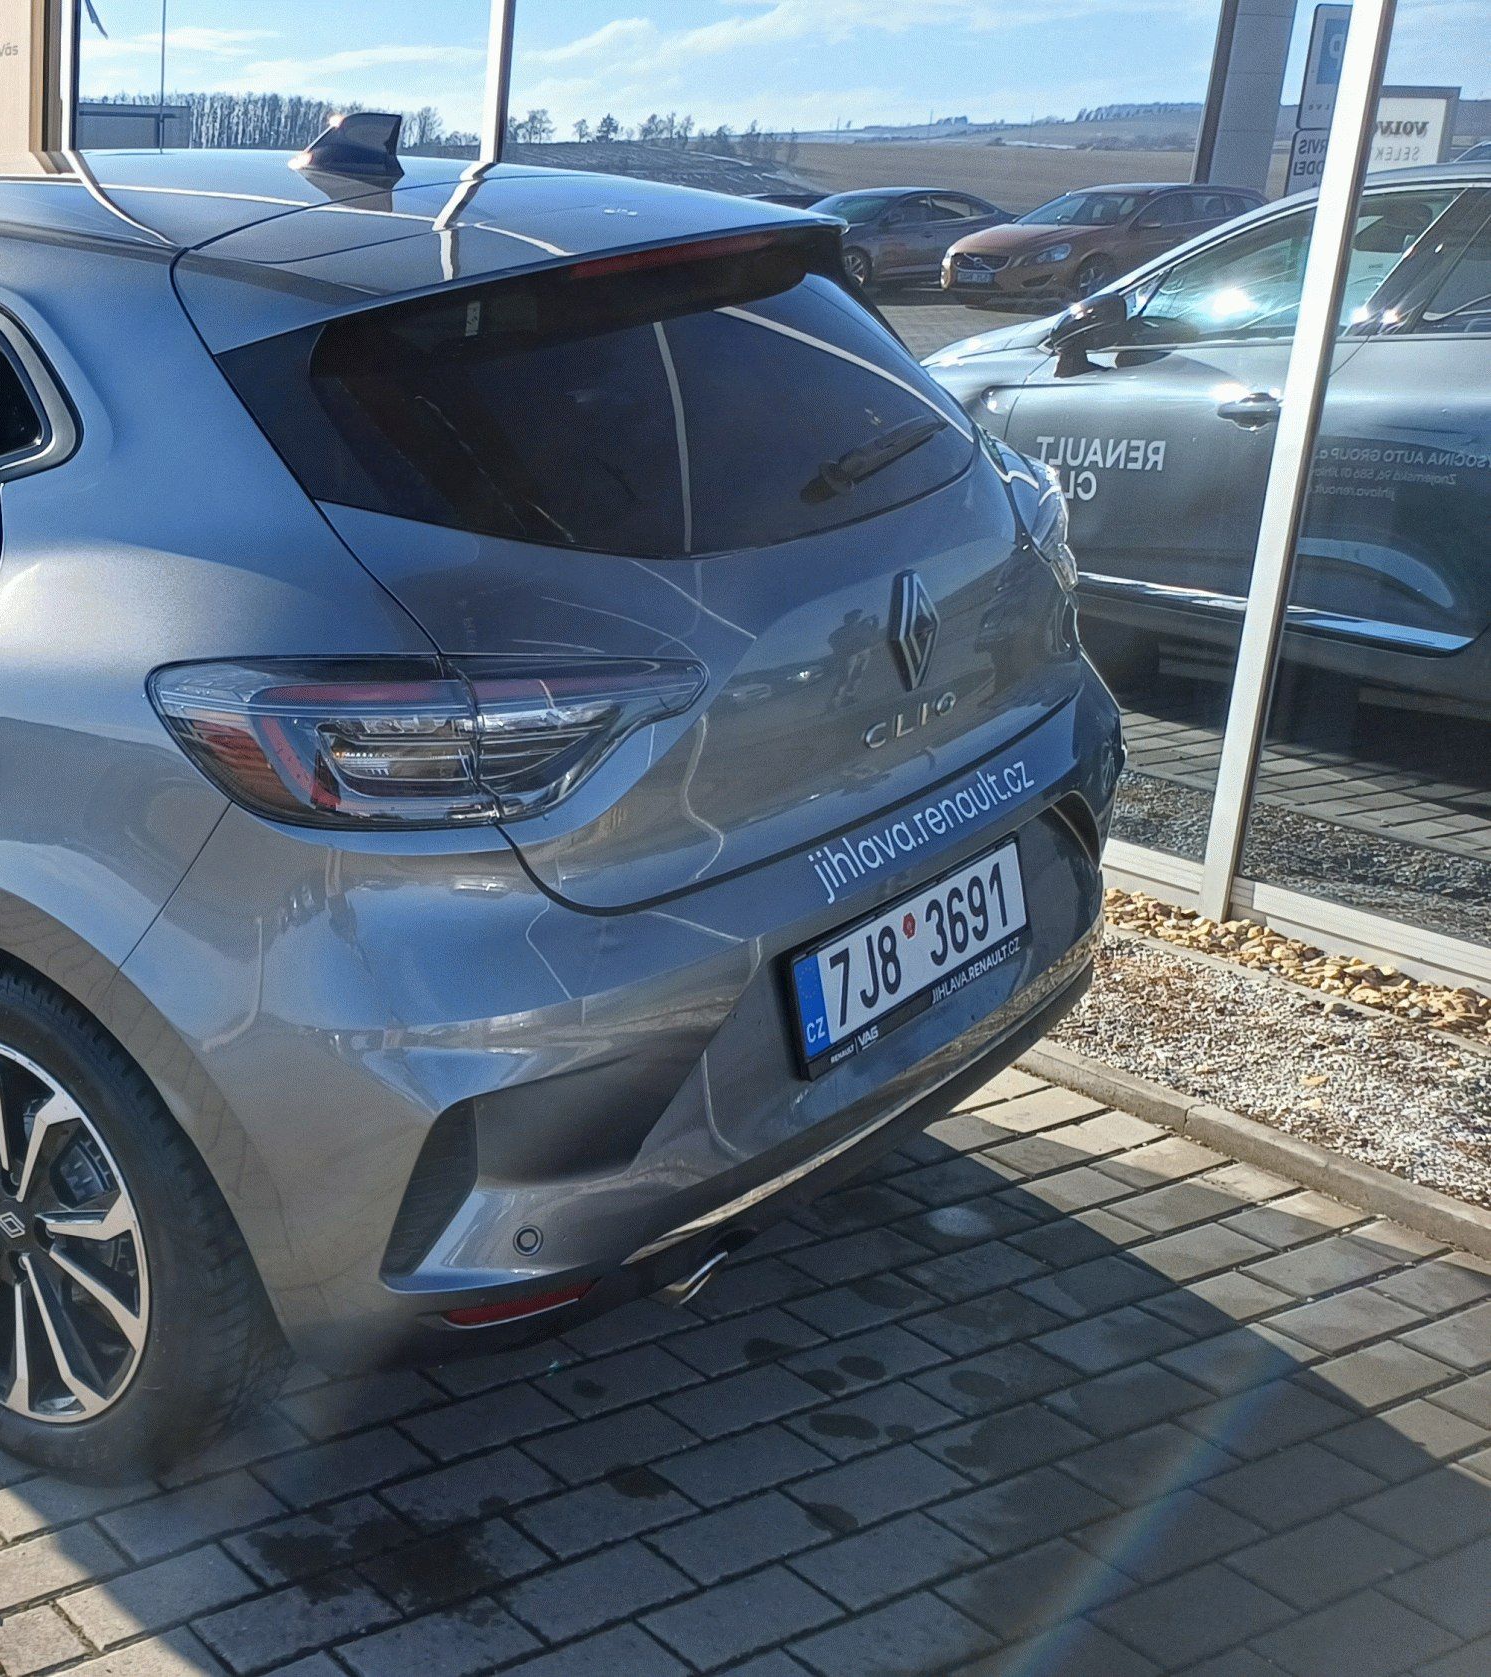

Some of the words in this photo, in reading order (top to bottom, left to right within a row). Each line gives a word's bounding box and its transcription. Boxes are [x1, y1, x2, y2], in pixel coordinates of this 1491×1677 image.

[863, 691, 956, 749] CLIO
[808, 761, 1035, 904] jihlava.renault.cz
[829, 925, 902, 1029] 7J8
[926, 862, 1009, 968] 3691
[931, 936, 1022, 1006] JIHLAVA.RENAULT.CZ
[806, 1015, 826, 1044] CZ
[830, 1044, 856, 1064] RENAULT
[858, 1025, 880, 1047] VAG
